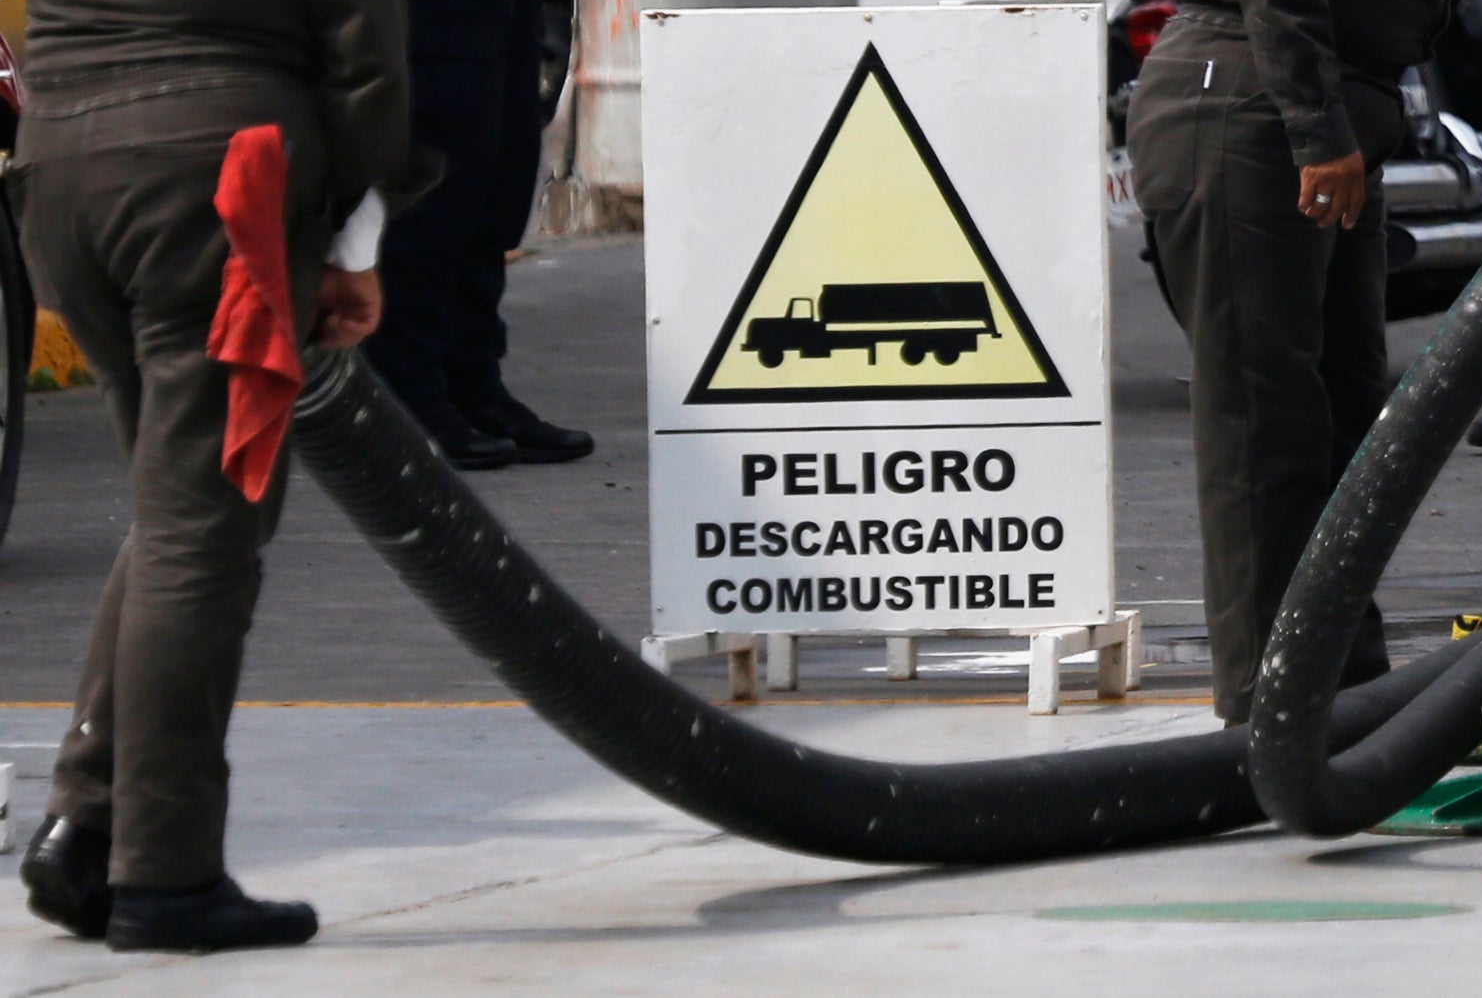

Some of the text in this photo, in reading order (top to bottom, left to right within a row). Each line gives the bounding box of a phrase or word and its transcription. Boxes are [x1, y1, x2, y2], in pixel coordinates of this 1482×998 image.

[741, 448, 1016, 497] PELIGRO
[695, 516, 1065, 559] DESCARGANDO
[706, 573, 1056, 615] COMBUSTIBLE
